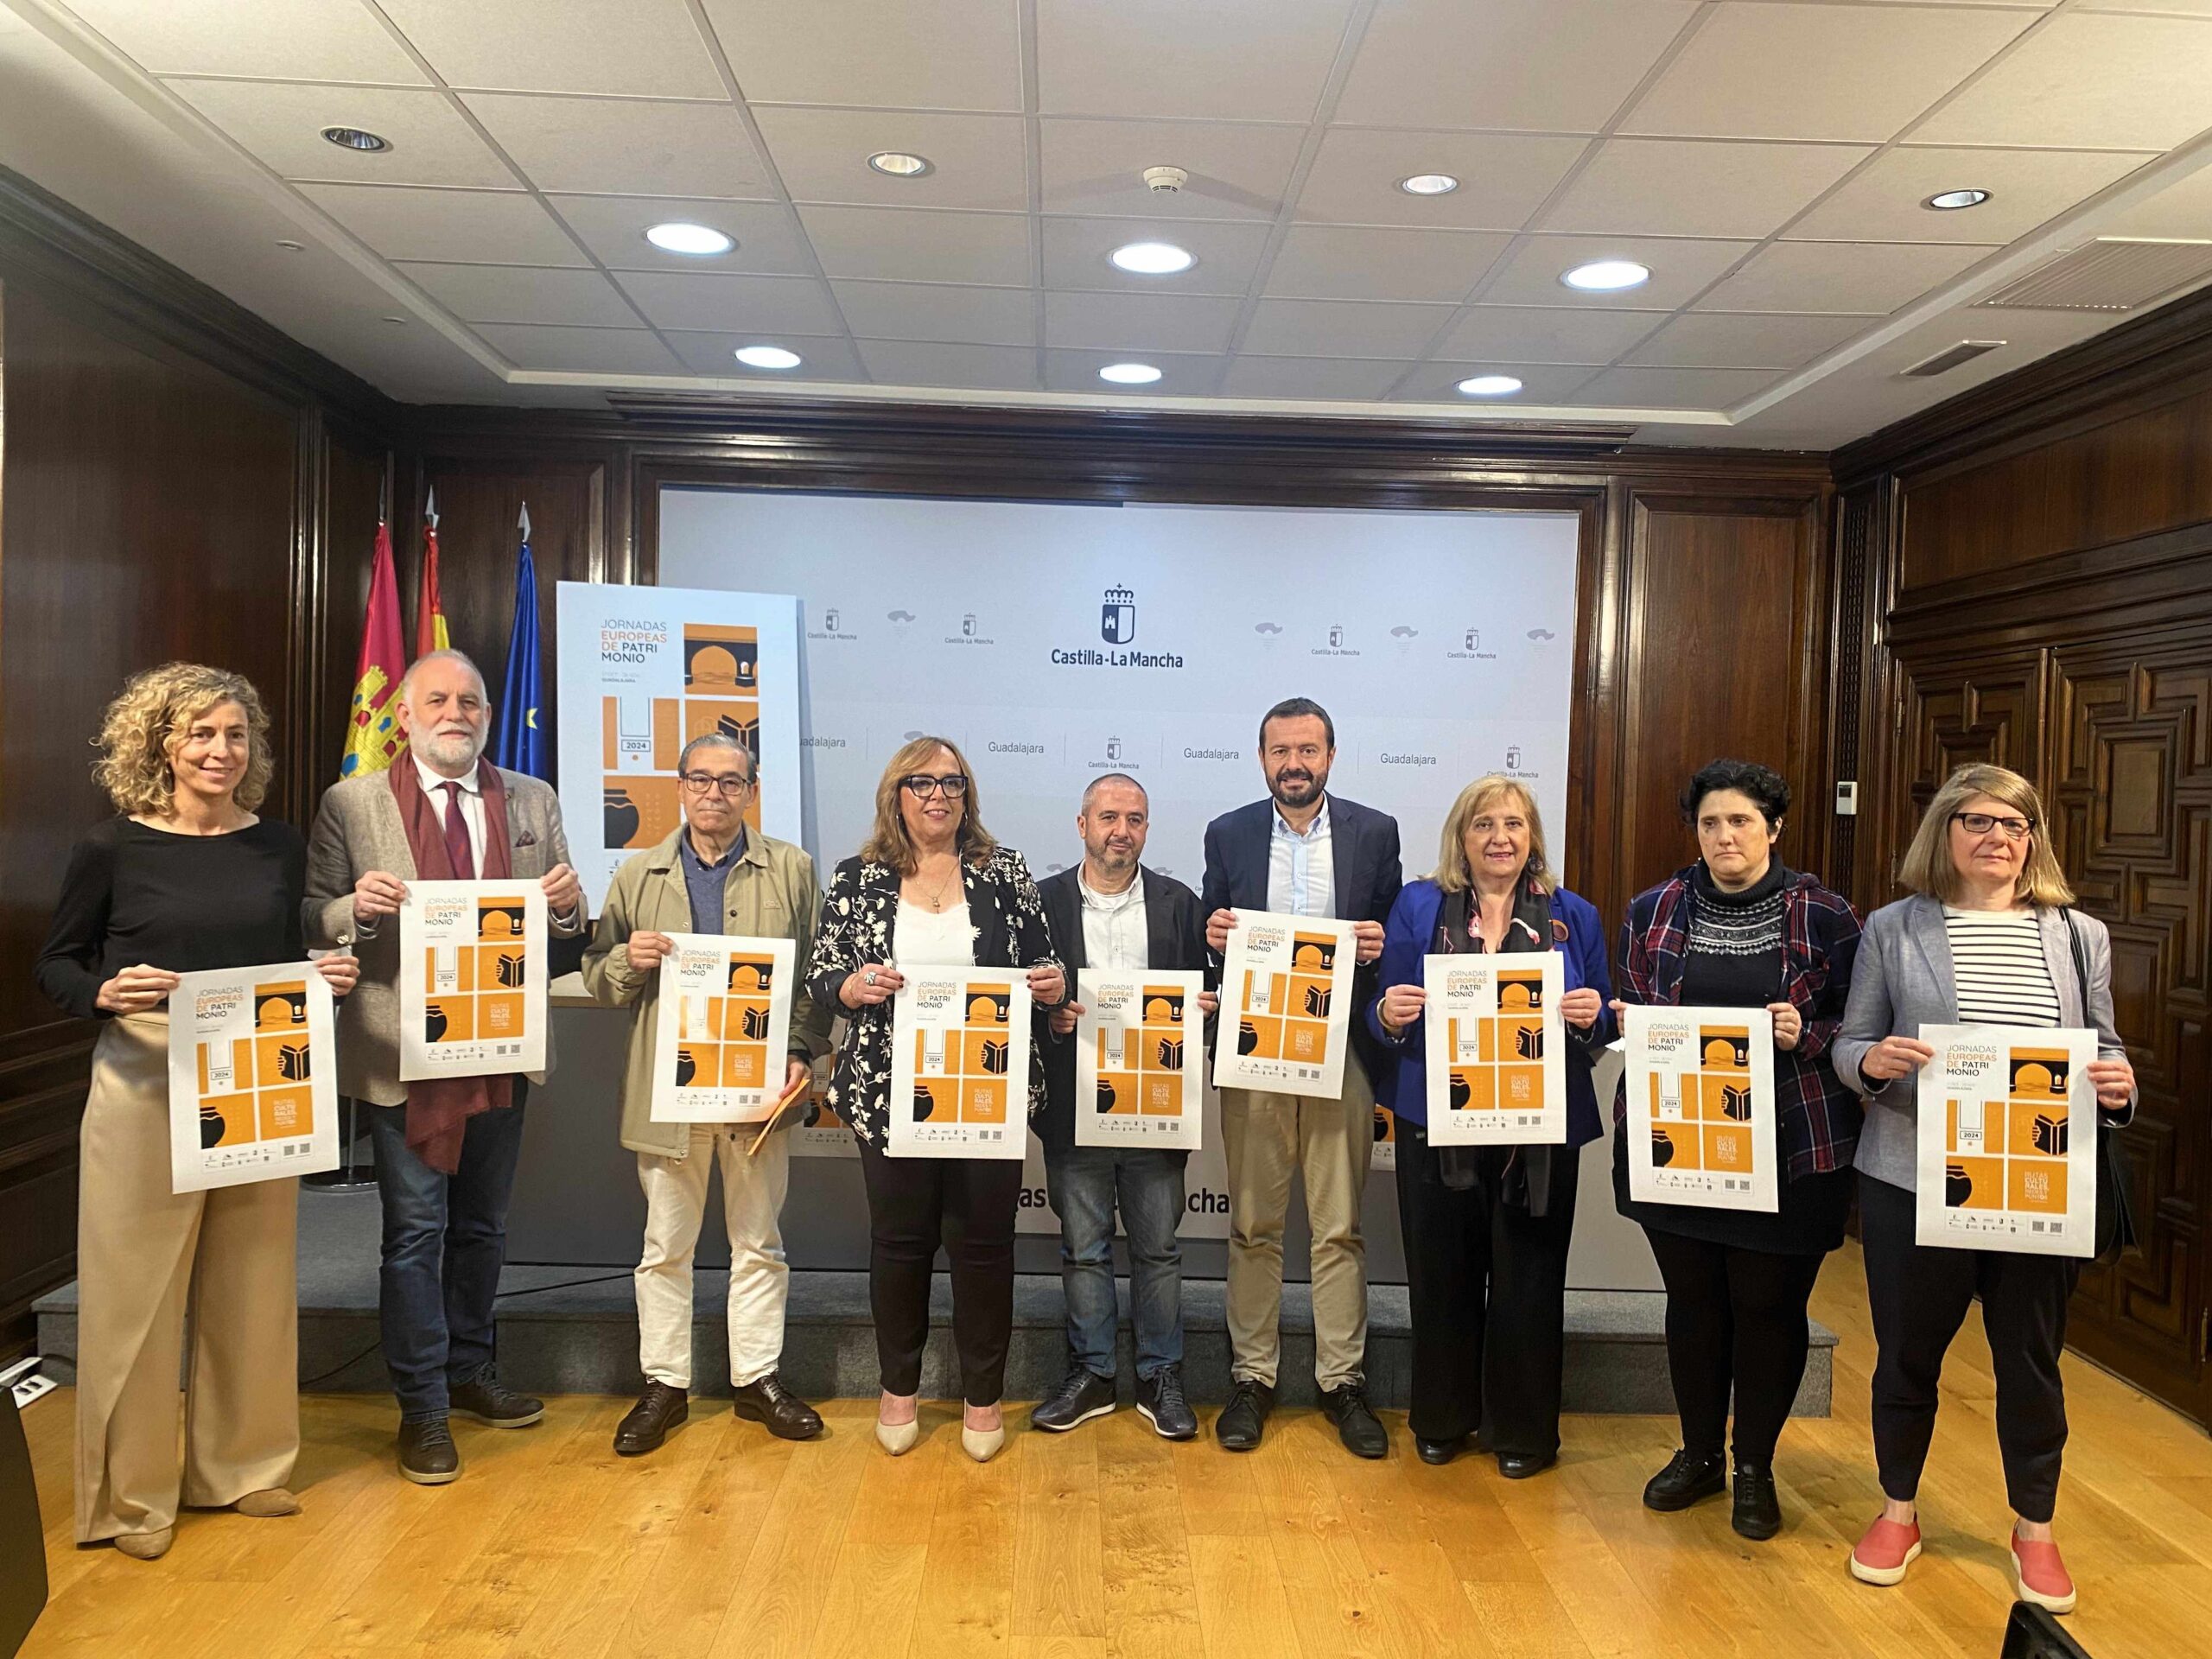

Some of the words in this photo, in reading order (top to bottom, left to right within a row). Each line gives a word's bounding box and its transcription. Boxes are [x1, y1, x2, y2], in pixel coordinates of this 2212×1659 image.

[601, 620, 666, 631] JORNADAS
[601, 631, 666, 643] EUROPEAS
[602, 642, 618, 651] DE
[622, 643, 657, 652] PATRI
[602, 653, 645, 663] MONIO
[1052, 649, 1128, 667] Castilla-La
[1130, 651, 1182, 668] Mancha
[988, 741, 1044, 754] Guadalajara
[1184, 747, 1239, 760] Guadalajara
[1381, 753, 1436, 766] Guadalajara
[1249, 926, 1285, 935] JORNADAS
[196, 986, 243, 997] JORNADAS
[196, 995, 243, 1006] EUROPEAS
[196, 1003, 208, 1012] DE
[211, 1002, 236, 1011] PATRI
[196, 1010, 226, 1019] MONIO
[1947, 1045, 1996, 1053] JORNADAS
[1947, 1053, 1997, 1062] EUROPEAS
[1187, 1188, 1230, 1213] cha
